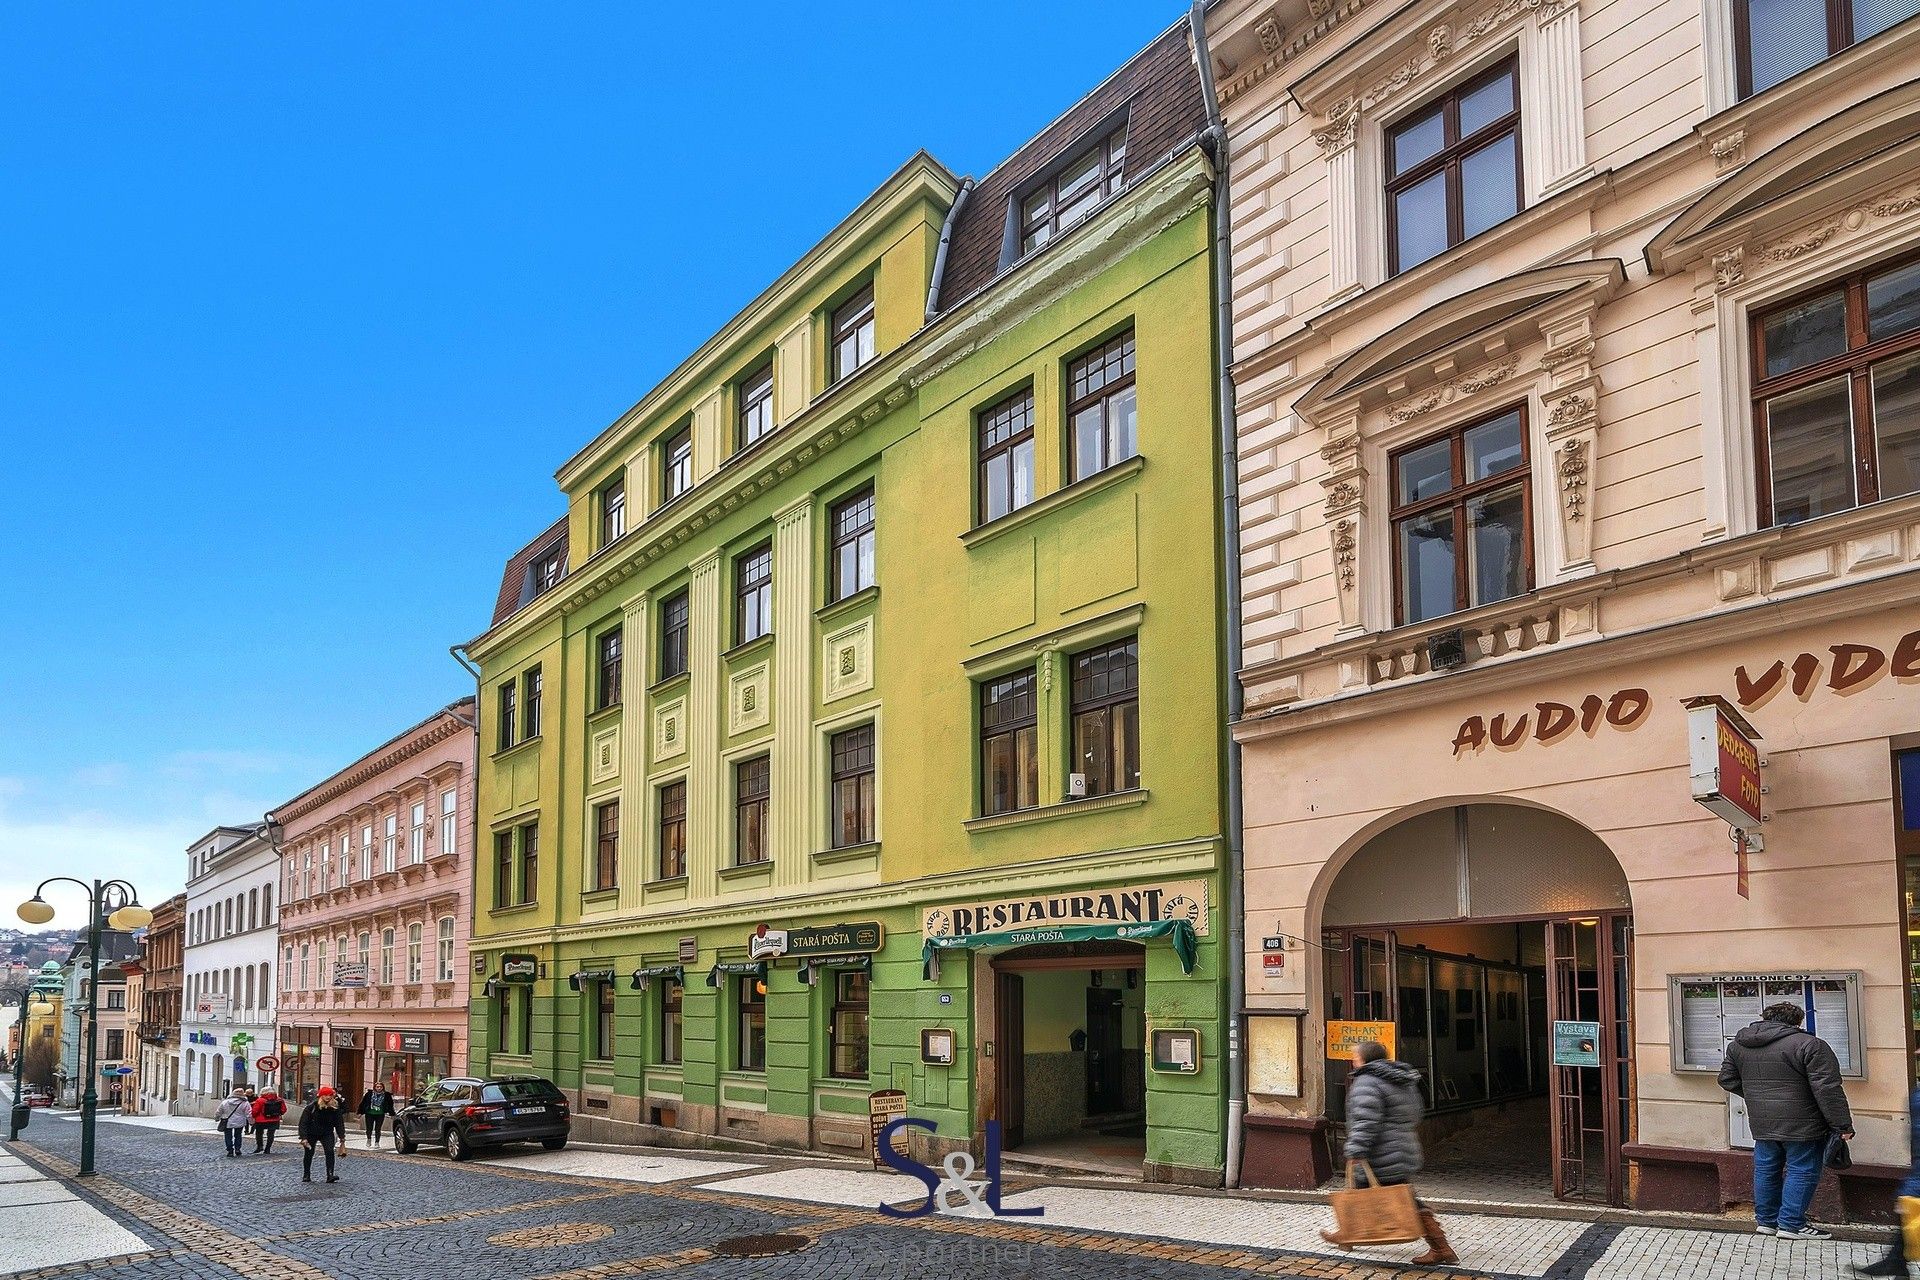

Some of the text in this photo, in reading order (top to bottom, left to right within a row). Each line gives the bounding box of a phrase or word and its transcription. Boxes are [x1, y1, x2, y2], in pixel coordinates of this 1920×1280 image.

[1452, 688, 1651, 757] AUDIO
[1717, 725, 1757, 775] DROGERIE
[1741, 774, 1759, 808] FOTO
[953, 888, 1164, 936] RESTAURANT
[793, 934, 820, 948] STARÁ
[821, 932, 850, 946] POŠTA
[1011, 931, 1064, 942] STARÁ POŠTA
[1341, 1025, 1385, 1036] RH-ART
[1556, 1023, 1595, 1035] Výstava
[333, 1031, 355, 1047] DISK
[874, 1097, 903, 1105] RESTAURANT
